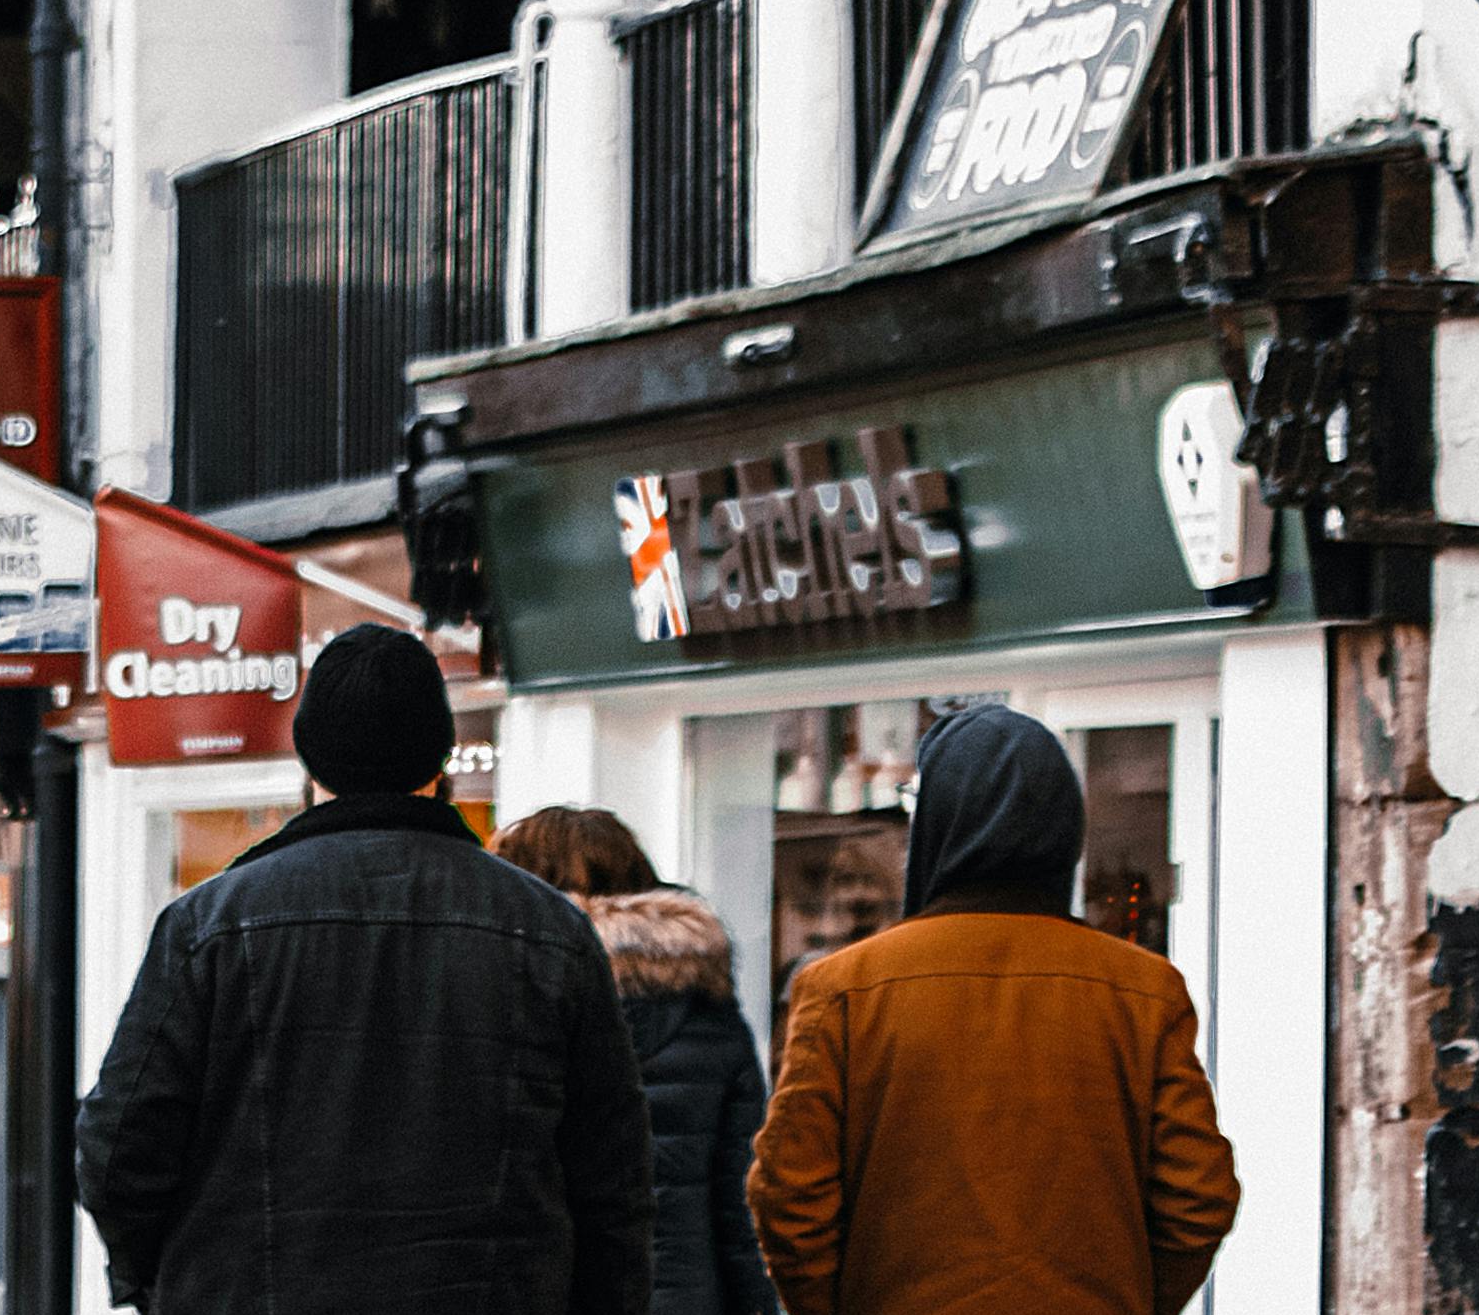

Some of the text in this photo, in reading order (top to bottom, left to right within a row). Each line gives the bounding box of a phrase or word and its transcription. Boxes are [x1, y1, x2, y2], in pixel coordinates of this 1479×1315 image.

[947, 62, 1087, 202] FOOD
[1, 417, 36, 446] ID
[160, 597, 241, 653] Dry
[107, 648, 297, 701] Cleaning
